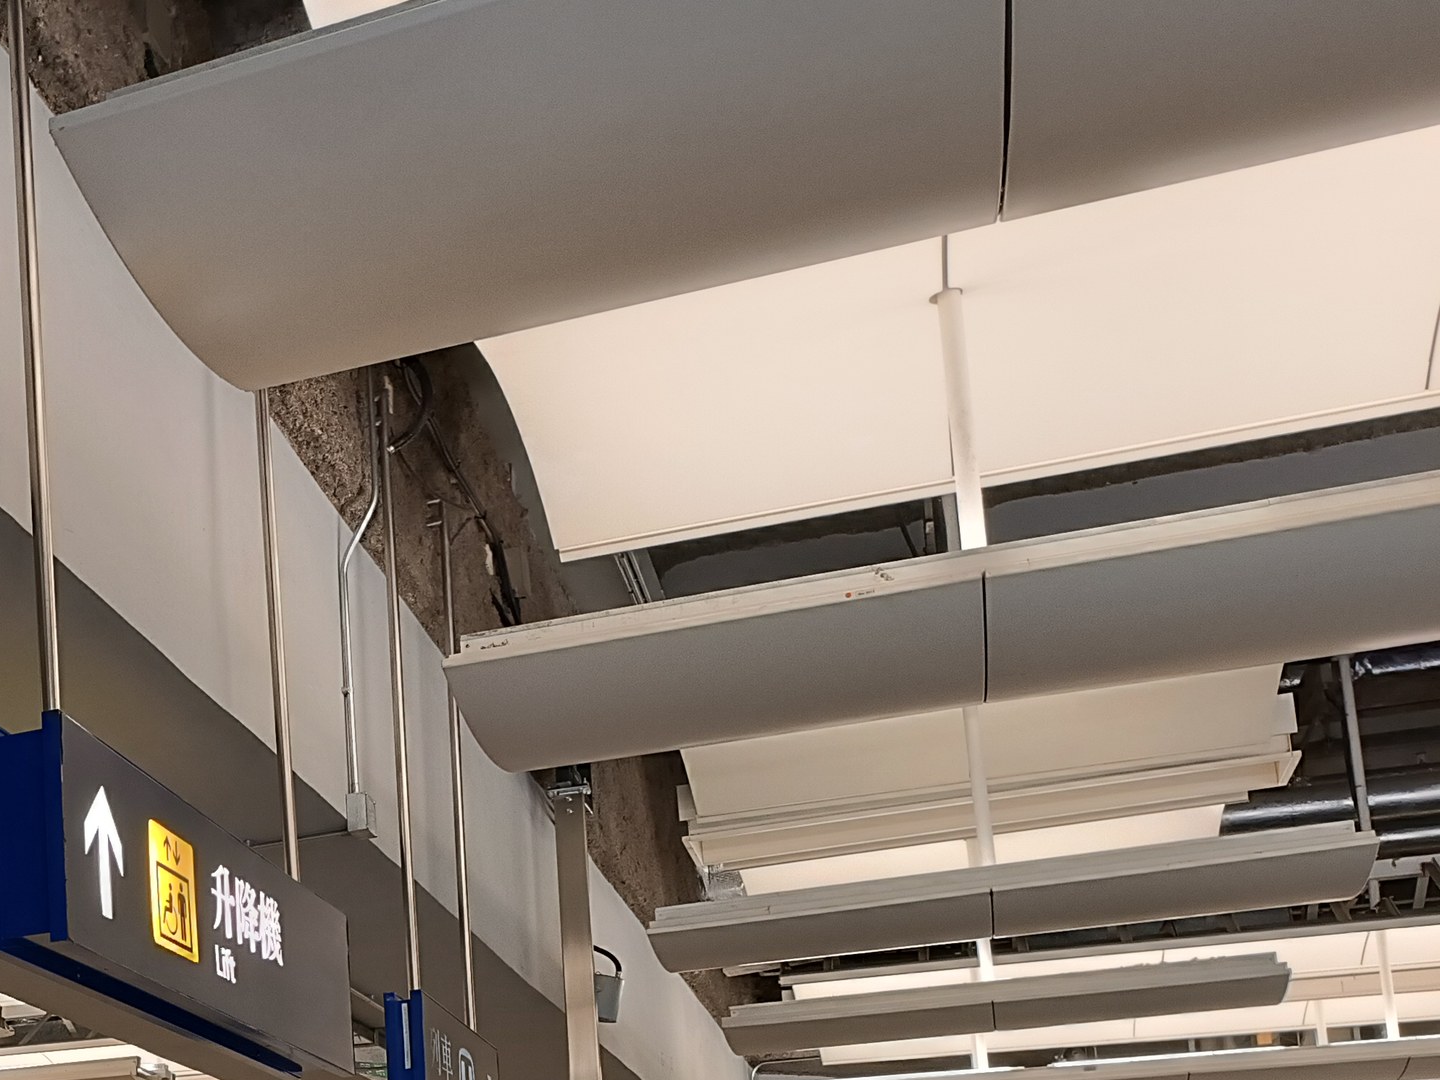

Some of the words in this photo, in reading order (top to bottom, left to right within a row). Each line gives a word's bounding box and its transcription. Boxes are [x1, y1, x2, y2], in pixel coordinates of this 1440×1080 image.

[211, 864, 284, 967] 升降機
[214, 944, 237, 984] Lift
